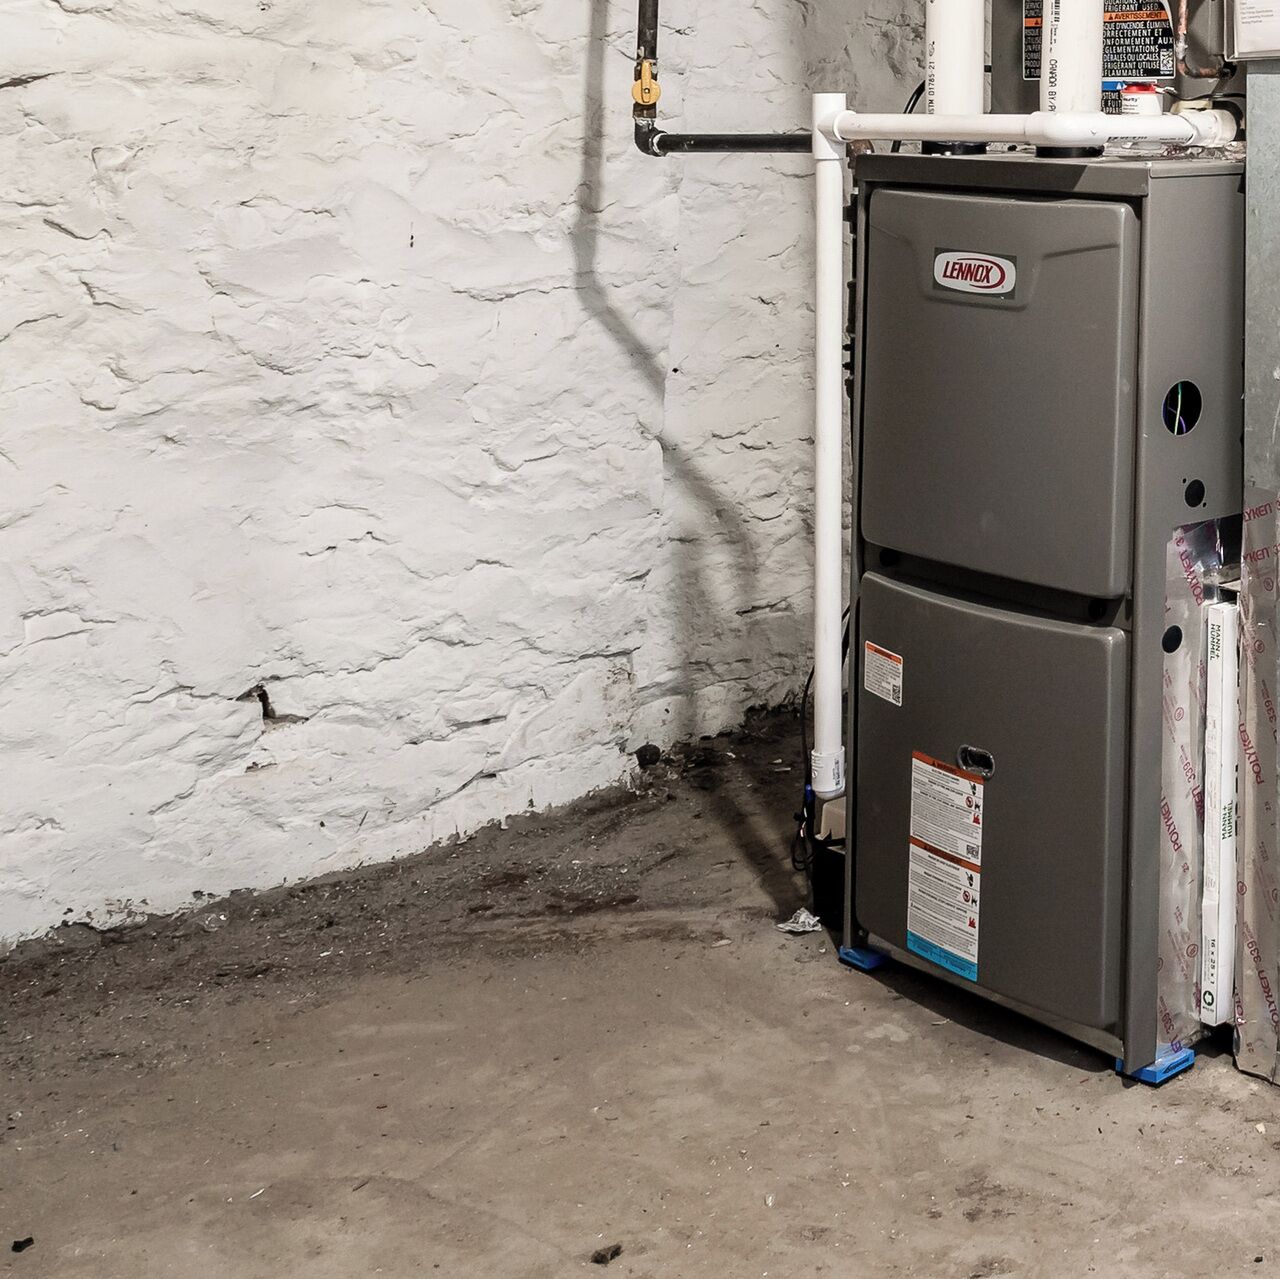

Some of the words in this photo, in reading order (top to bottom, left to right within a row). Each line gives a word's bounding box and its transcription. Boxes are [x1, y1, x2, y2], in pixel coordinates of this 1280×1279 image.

[1114, 12, 1163, 20] AVERTISSEMENT
[1154, 28, 1163, 36] ET
[1157, 36, 1173, 45] AUX
[1126, 53, 1136, 61] OU
[927, 61, 937, 97] D1785-21
[1047, 59, 1058, 87] CANADA
[942, 260, 994, 284] LENNOX
[1214, 624, 1222, 660] MANN+
[1181, 761, 1196, 784] 339
[1226, 799, 1234, 839] HUMMEL
[1210, 938, 1216, 947] 16
[1246, 939, 1262, 964] 339
